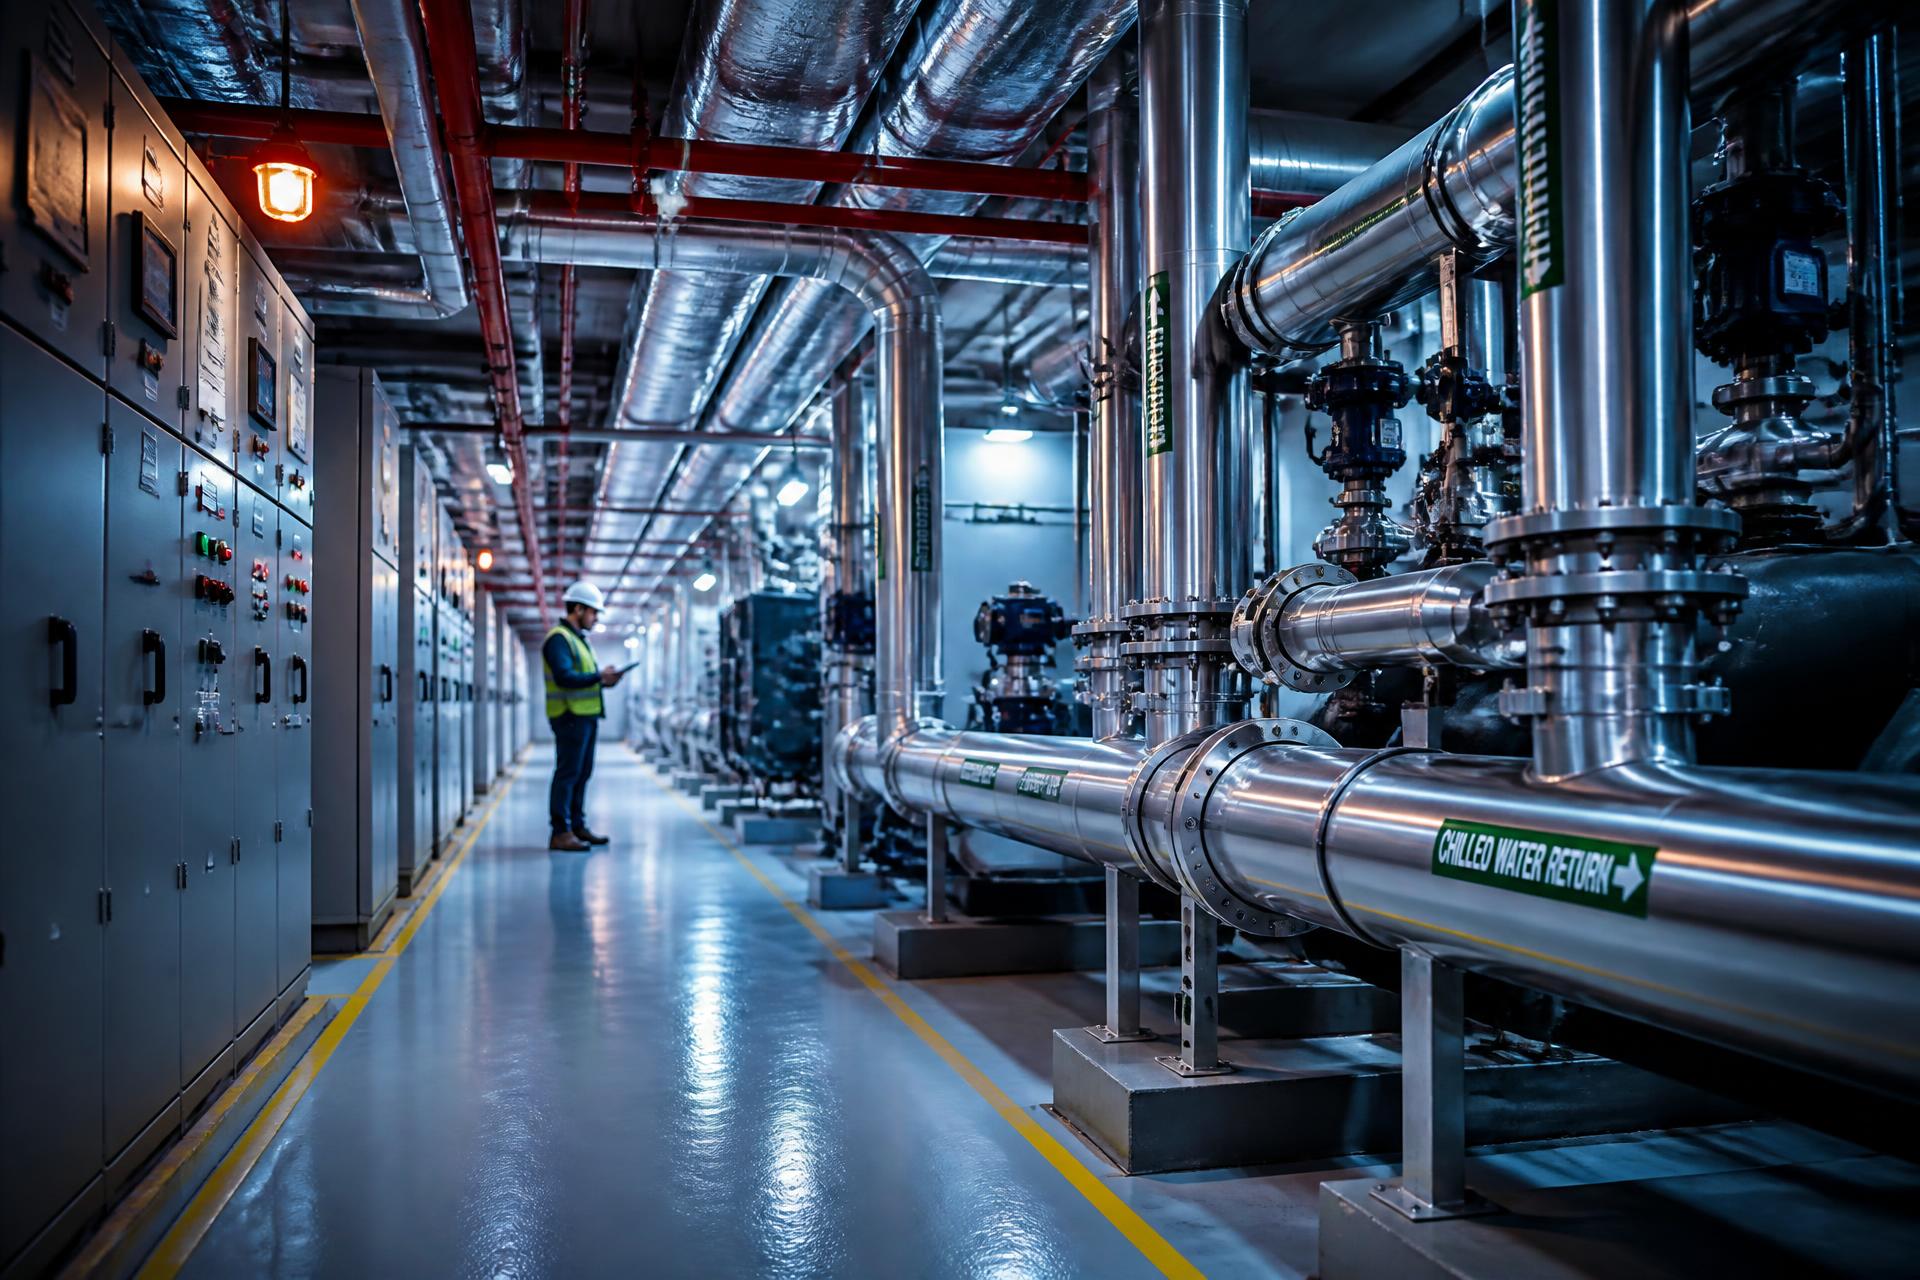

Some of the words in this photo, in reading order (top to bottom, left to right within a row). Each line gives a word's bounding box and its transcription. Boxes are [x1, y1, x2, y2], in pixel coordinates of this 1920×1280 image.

[1438, 829, 1495, 872] CHILLED
[1494, 837, 1547, 882] WATER
[1545, 844, 1615, 895] RETURN
